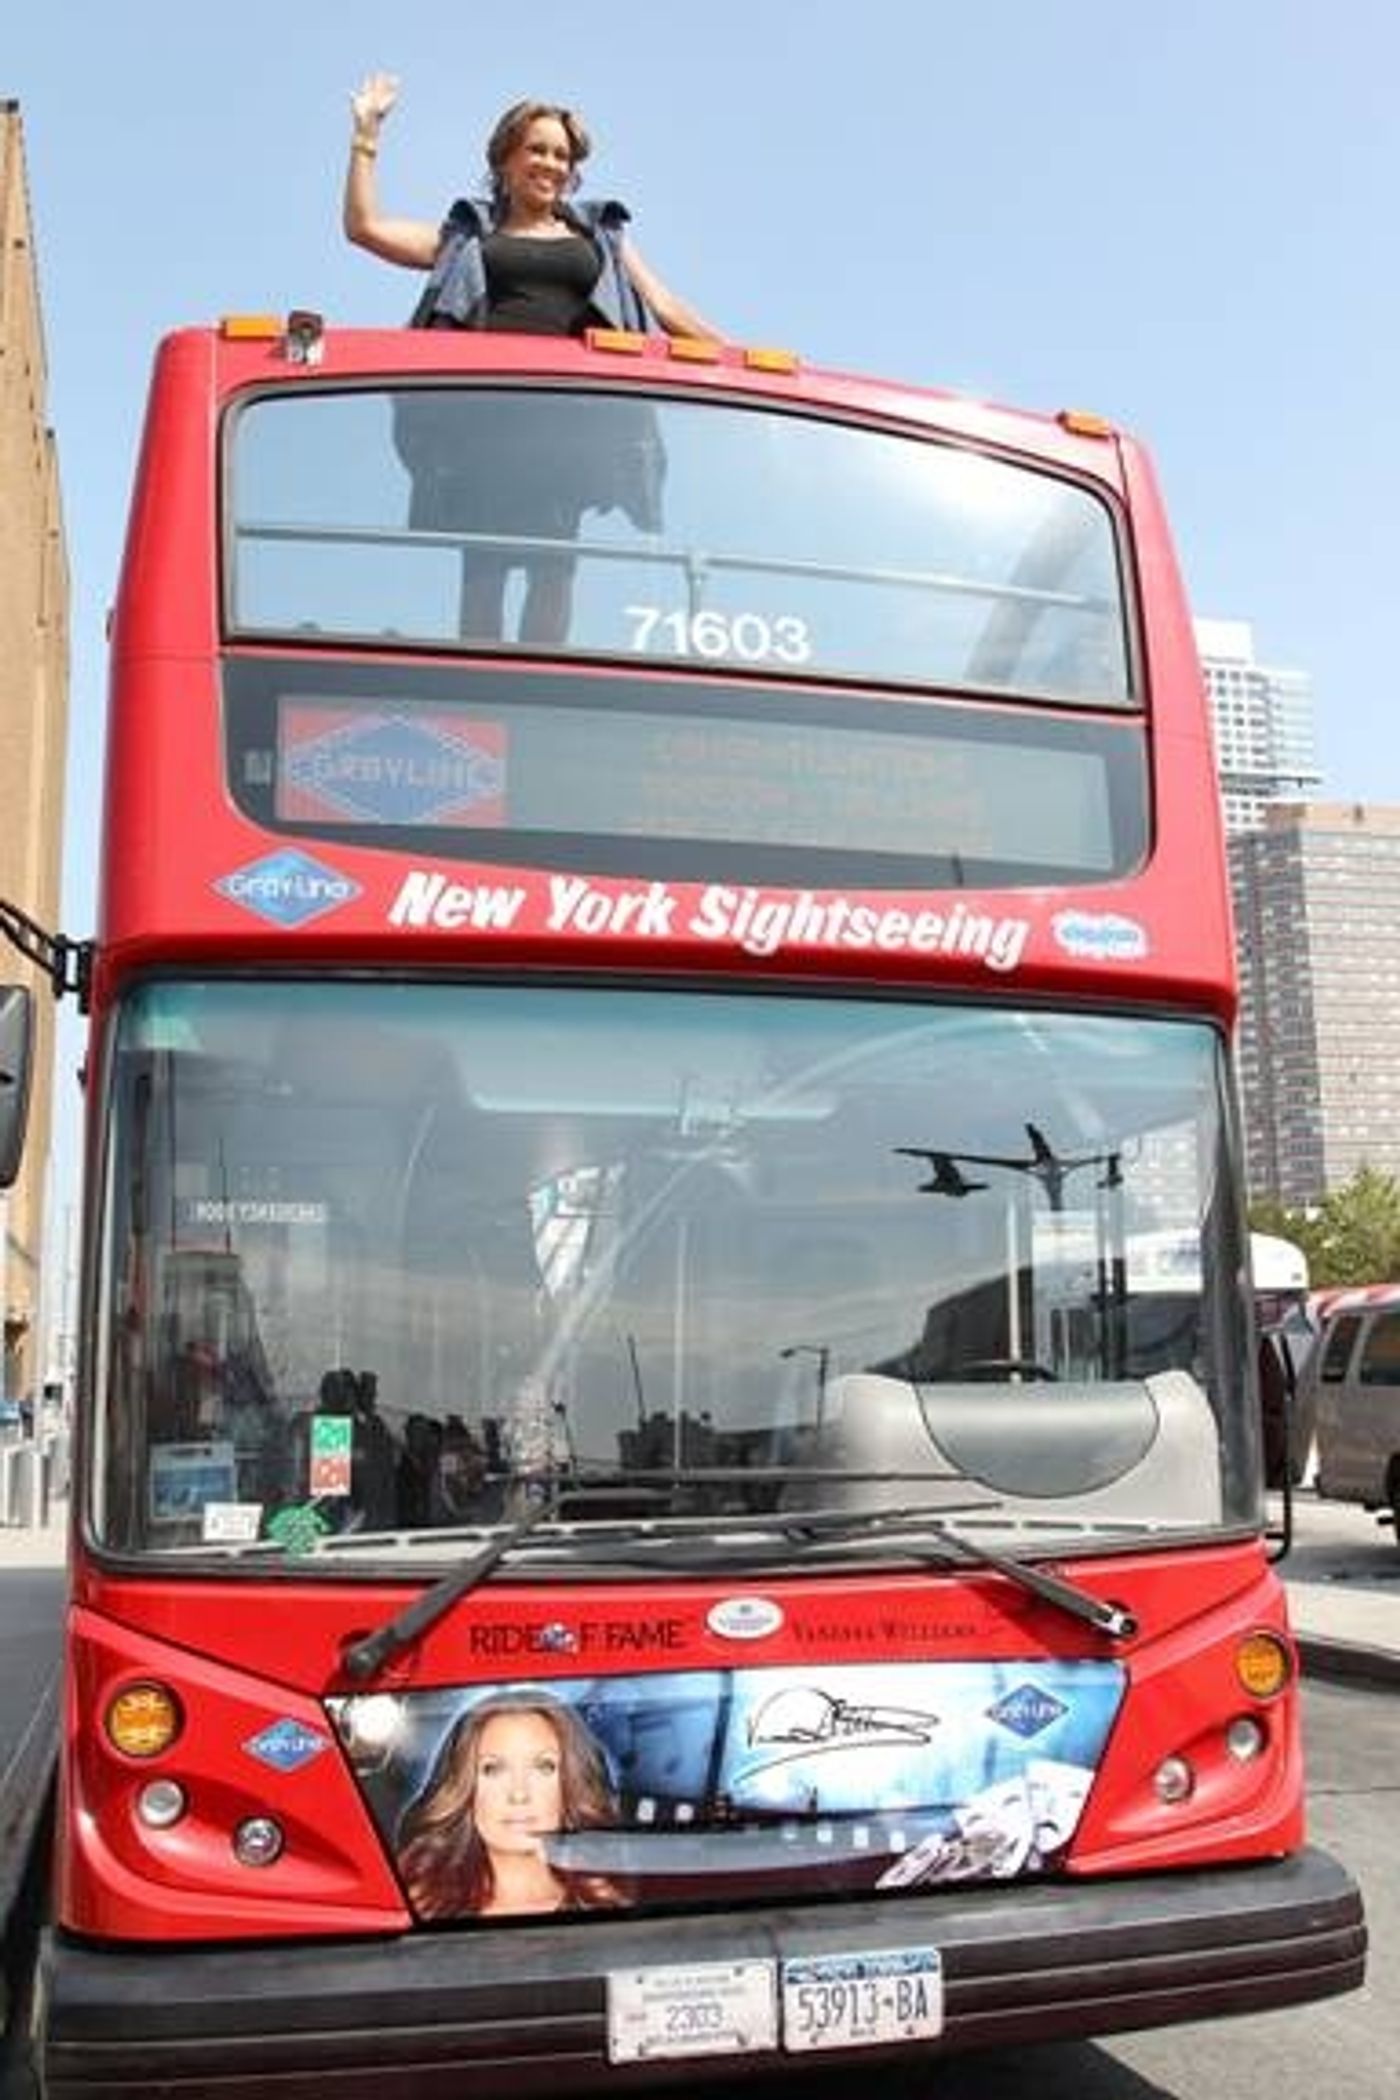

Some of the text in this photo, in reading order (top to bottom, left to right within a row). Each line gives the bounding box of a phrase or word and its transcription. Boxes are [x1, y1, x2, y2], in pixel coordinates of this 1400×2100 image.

[624, 606, 811, 662] 71603
[388, 870, 527, 929] New
[547, 874, 678, 936] York
[689, 885, 1029, 972] Sightseeing
[604, 1618, 686, 1650] FAME
